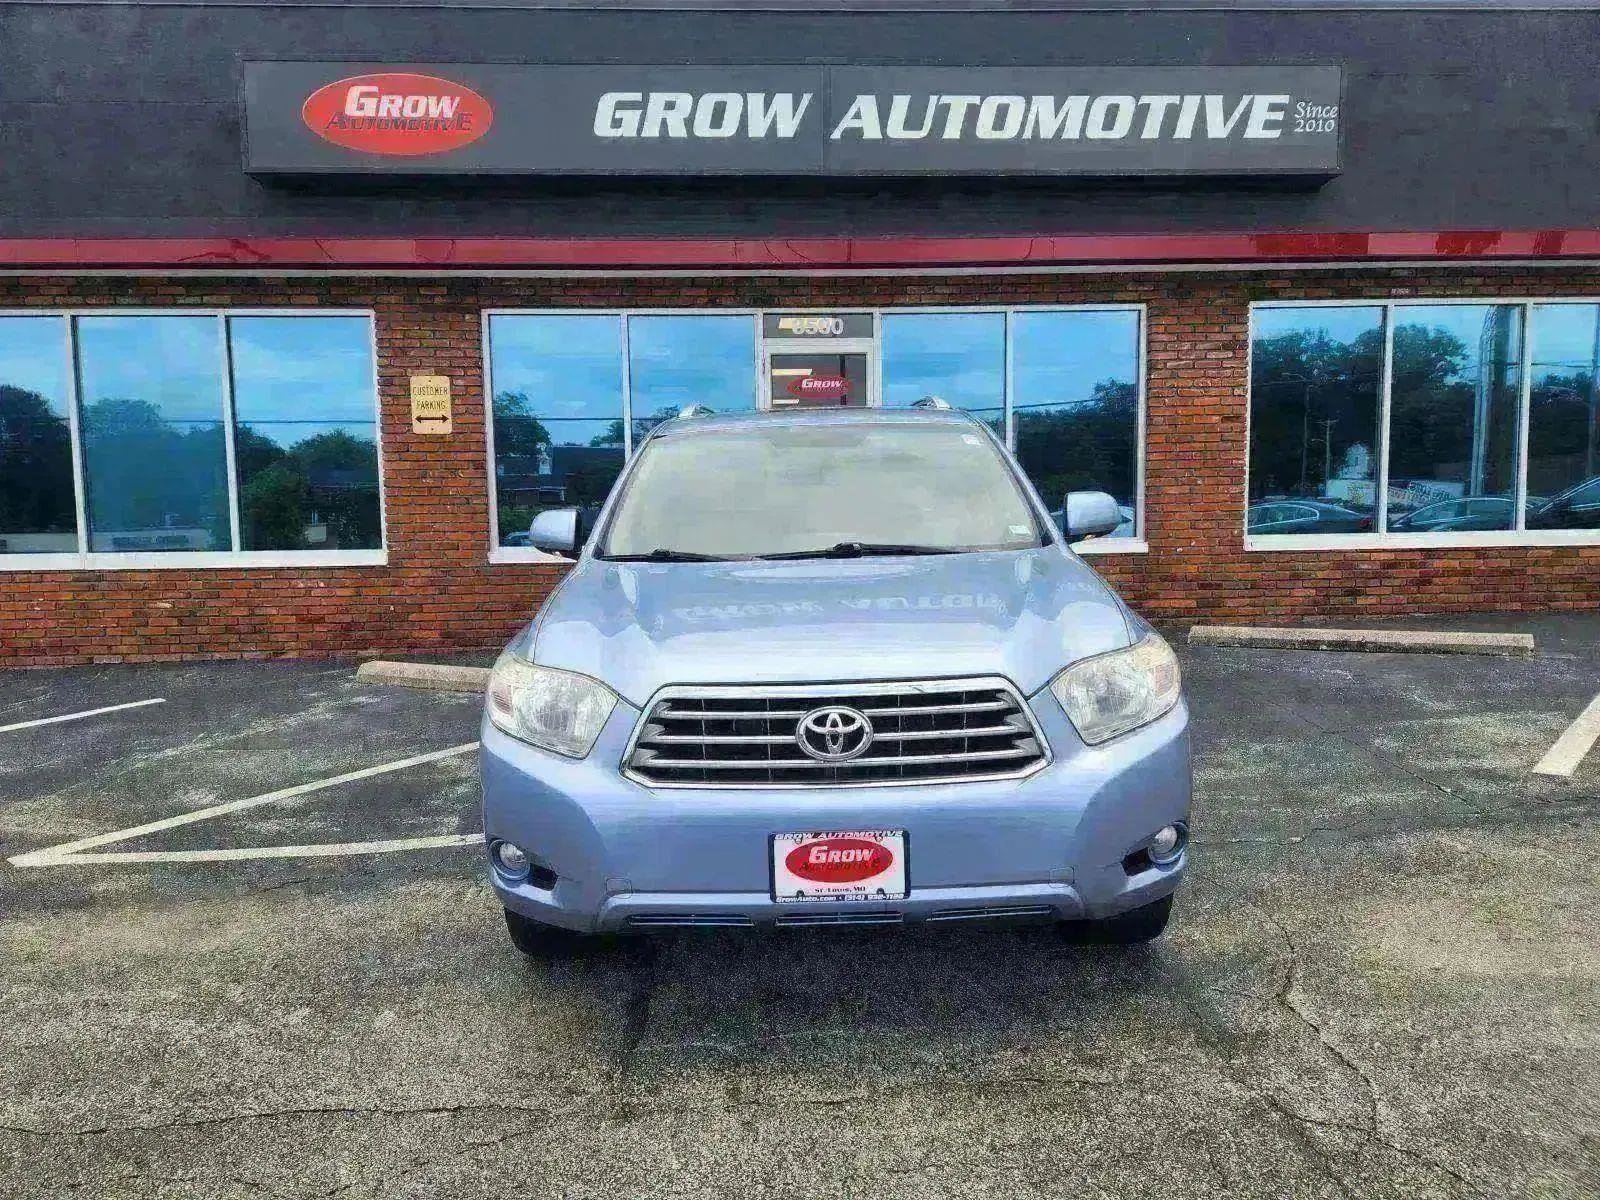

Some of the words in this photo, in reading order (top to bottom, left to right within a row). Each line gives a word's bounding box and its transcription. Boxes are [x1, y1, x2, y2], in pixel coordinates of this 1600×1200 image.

[345, 85, 460, 119] GROW
[1294, 101, 1339, 118] Since
[325, 112, 473, 131] AUTOMOTIVE
[593, 92, 813, 138] GROW
[830, 94, 1290, 140] AUTOMOTIVE
[1294, 119, 1335, 132] 2010
[802, 378, 843, 388] GROW
[412, 386, 448, 396] CUSTOMER
[416, 400, 446, 410] PARKING
[775, 832, 814, 840] GROW
[819, 830, 904, 840] AUTOMOTIVE
[809, 845, 874, 863] GROW
